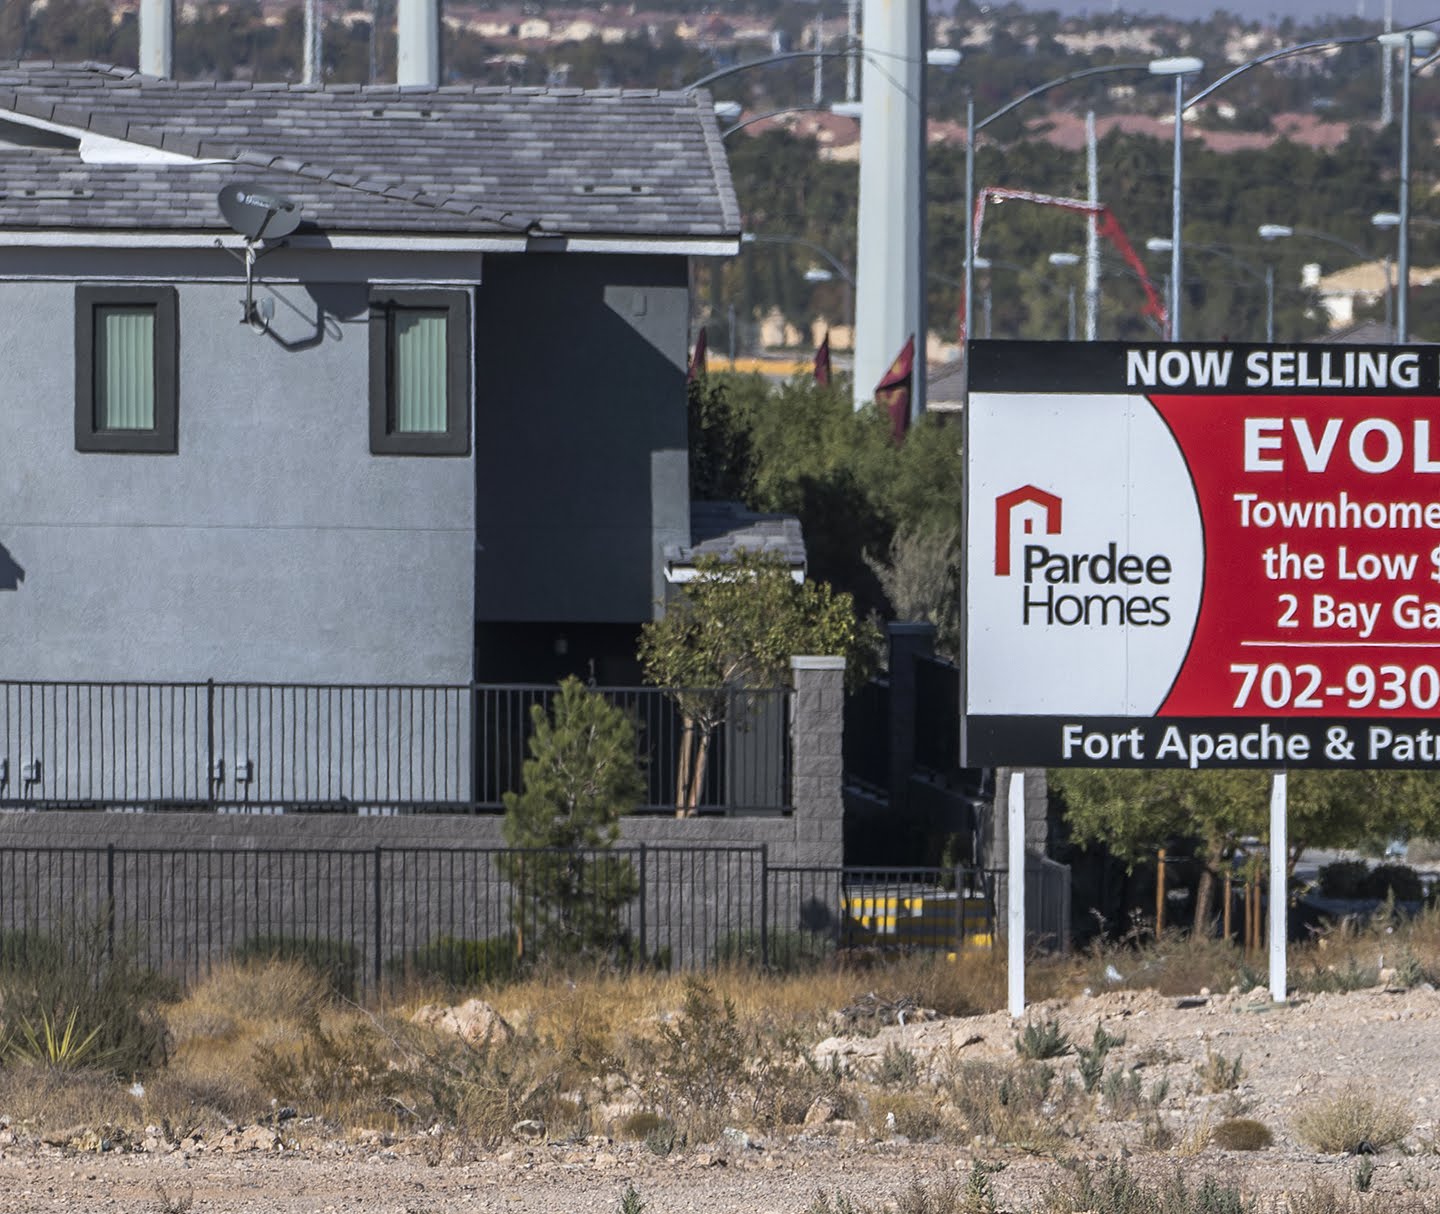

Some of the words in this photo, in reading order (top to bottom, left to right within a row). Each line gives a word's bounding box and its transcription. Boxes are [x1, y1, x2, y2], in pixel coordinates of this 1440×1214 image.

[1127, 351, 1232, 386] NOW
[1247, 352, 1419, 387] SELLING
[1024, 543, 1171, 584] Pardee
[1262, 543, 1324, 579] the
[1339, 546, 1418, 580] Low
[1024, 586, 1170, 626] Homes
[1278, 594, 1298, 627] 2
[1313, 595, 1381, 637] Bay
[1063, 725, 1144, 759] Fort
[1156, 724, 1309, 768] Apache
[1325, 727, 1355, 759] &
